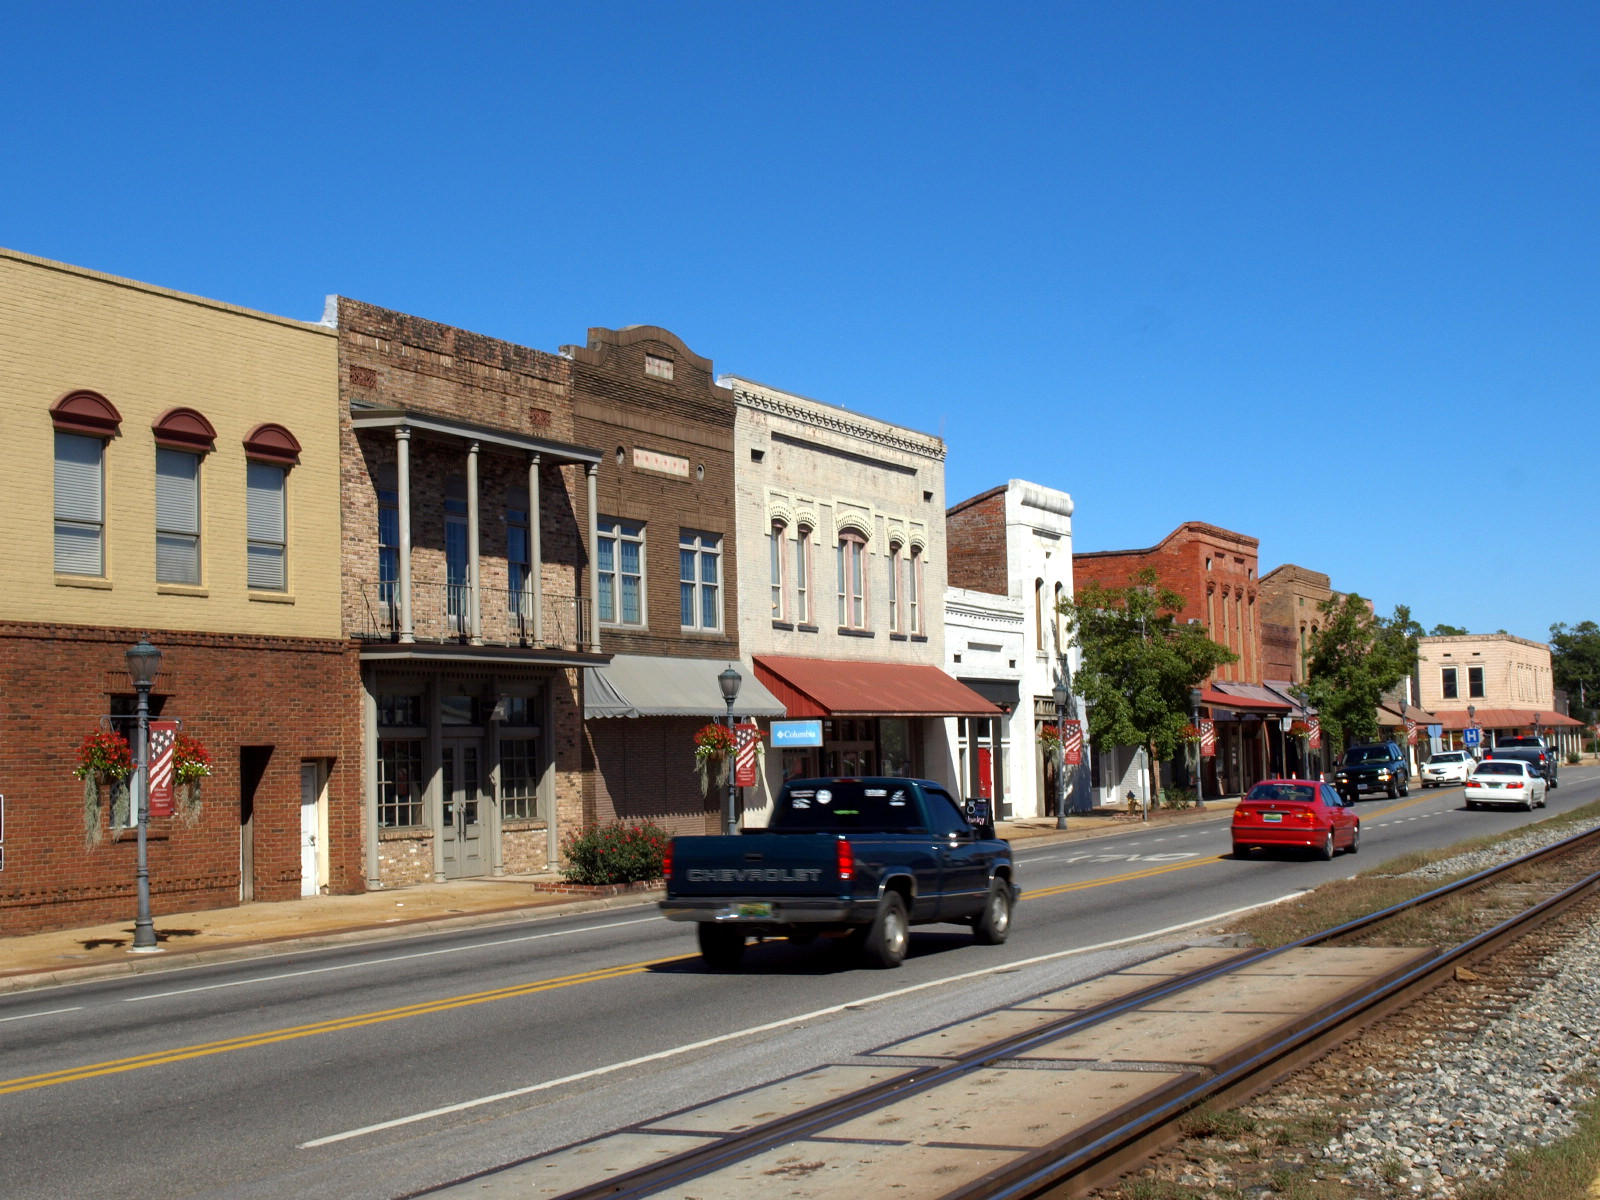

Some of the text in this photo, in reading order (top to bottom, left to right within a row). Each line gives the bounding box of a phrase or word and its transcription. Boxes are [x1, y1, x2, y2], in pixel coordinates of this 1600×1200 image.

[784, 730, 816, 739] Columbia
[1466, 730, 1477, 742] H
[686, 868, 823, 882] CHEVROLET
